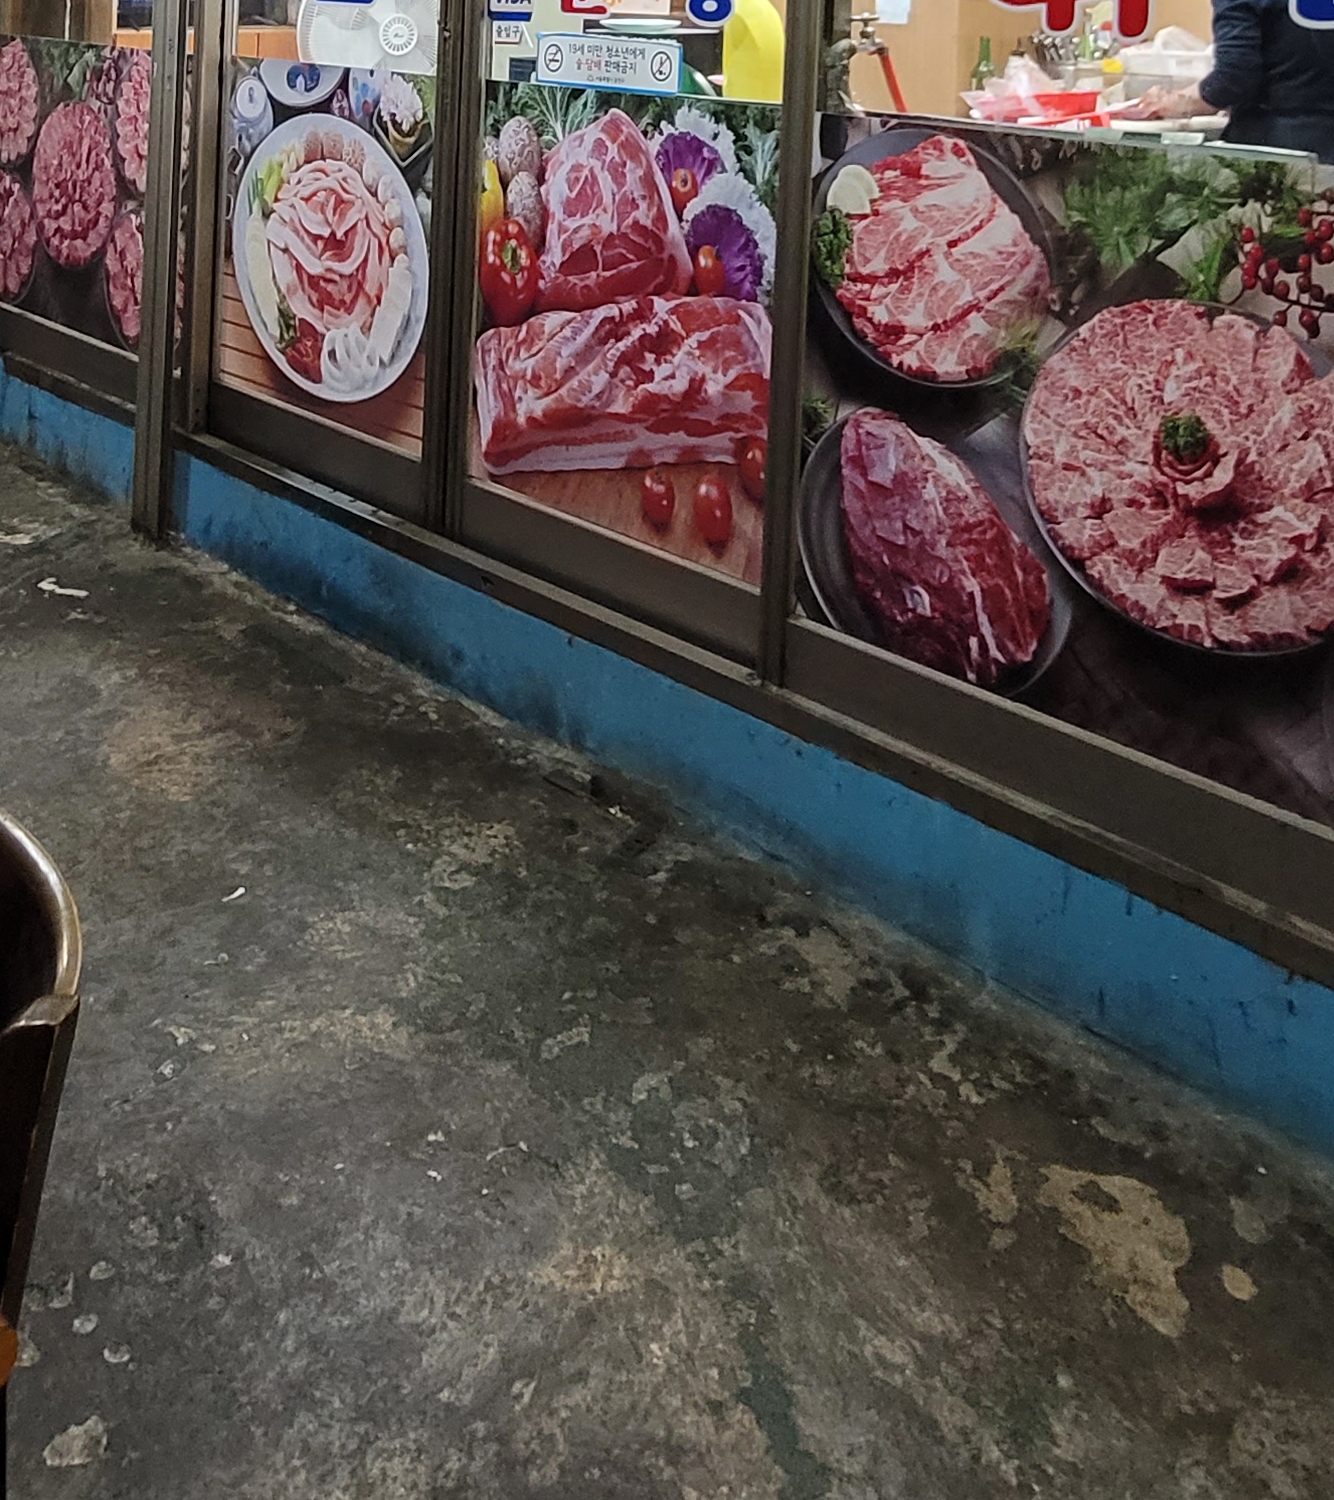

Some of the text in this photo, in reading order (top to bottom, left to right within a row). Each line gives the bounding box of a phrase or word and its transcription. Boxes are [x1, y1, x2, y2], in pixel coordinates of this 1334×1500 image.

[569, 43, 646, 61] 19세 미만 청소년에게
[604, 60, 637, 75] 판매금지
